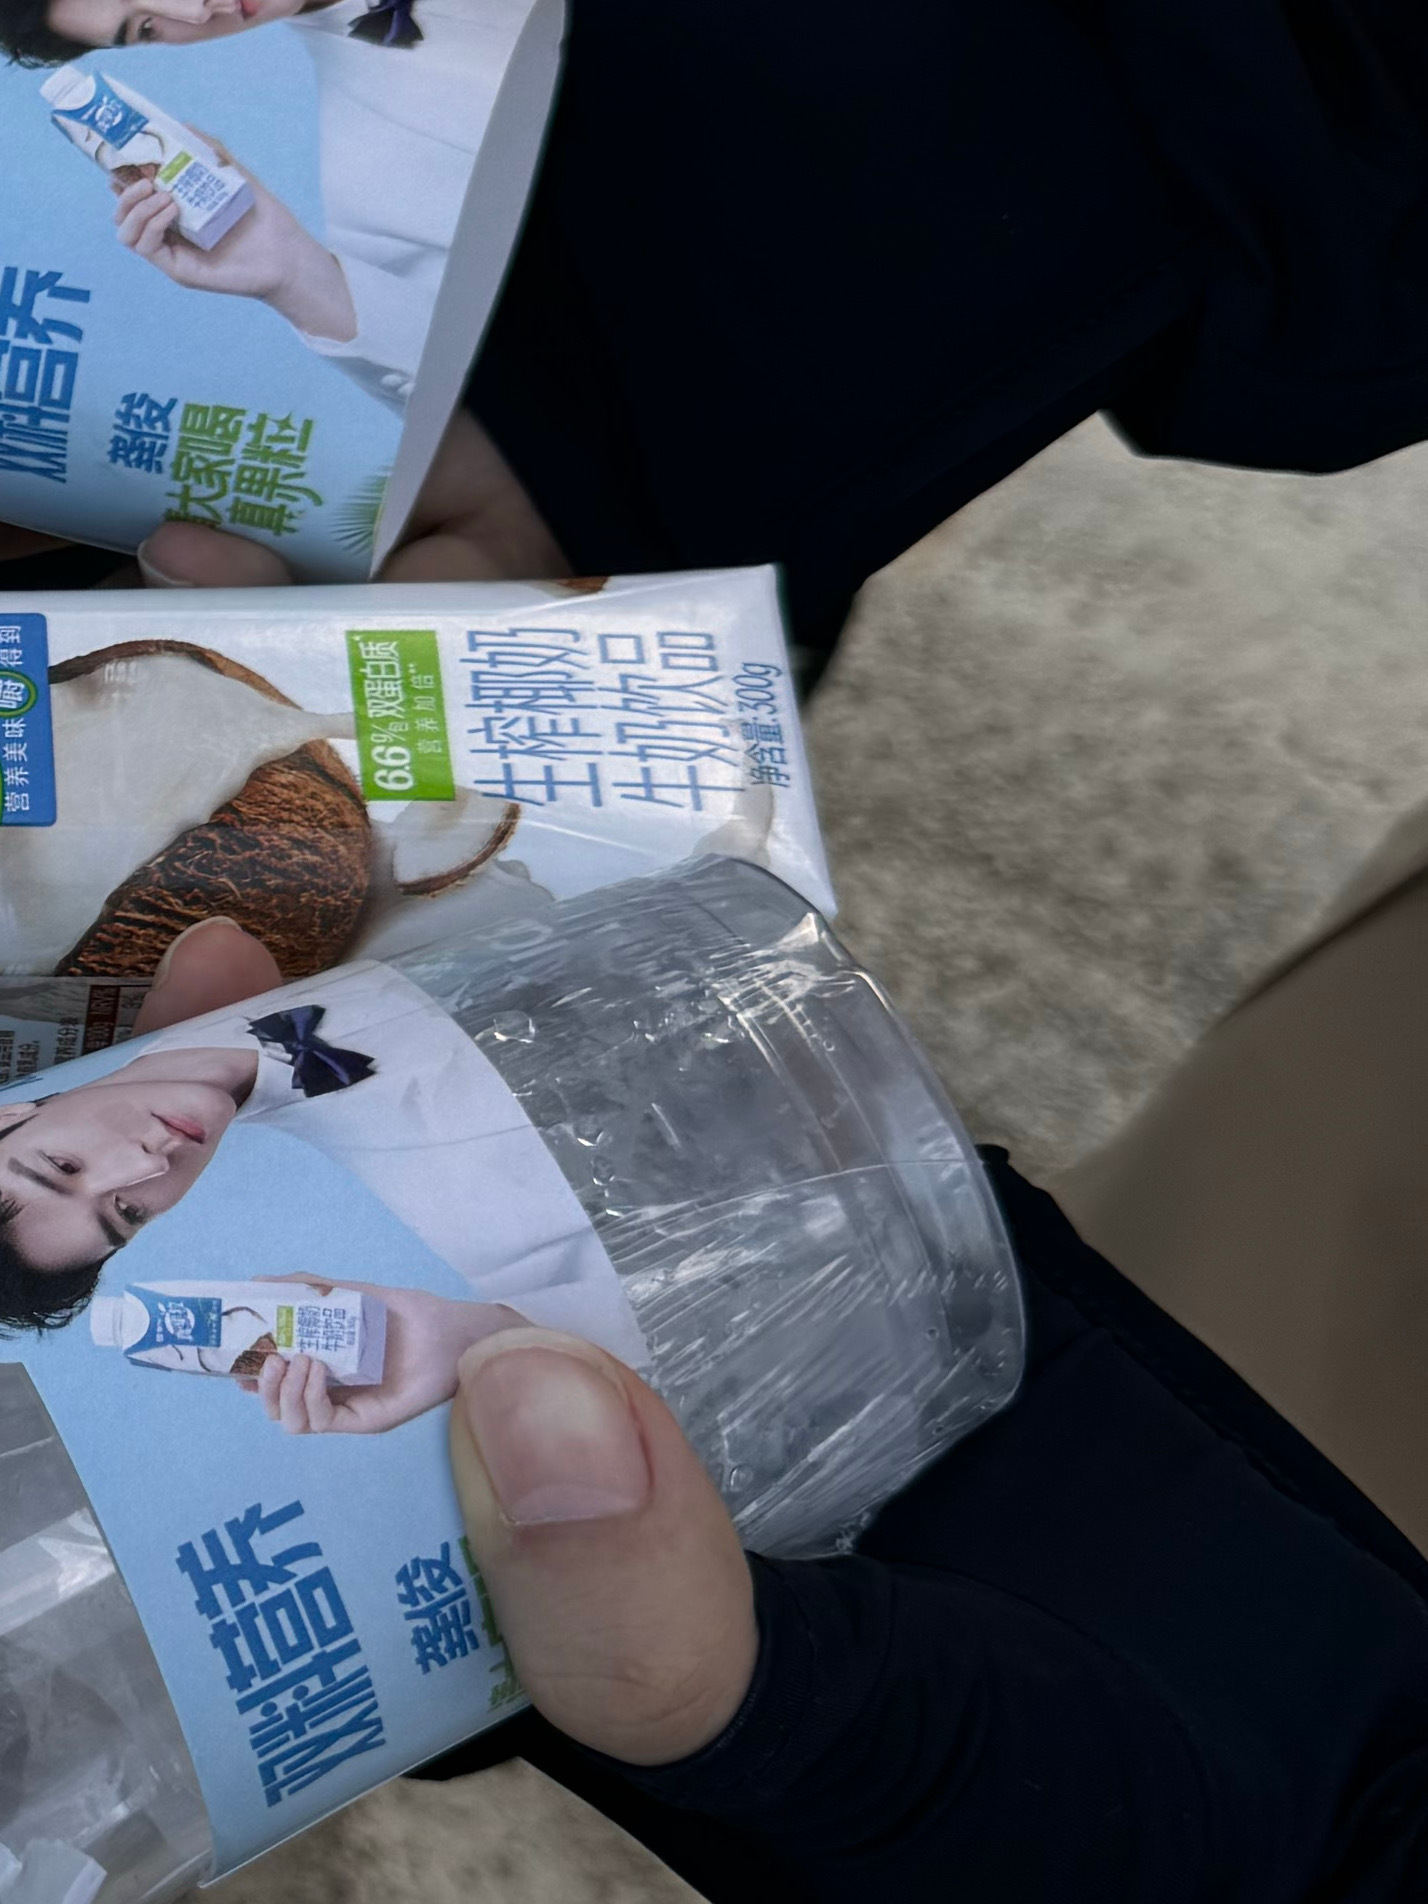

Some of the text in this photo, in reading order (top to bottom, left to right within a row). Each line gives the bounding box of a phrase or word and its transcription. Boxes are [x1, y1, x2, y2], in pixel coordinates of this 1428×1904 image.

[106, 391, 178, 476] 龚俊
[163, 402, 247, 530] 大家喝
[226, 410, 324, 538] 真果粒
[459, 627, 604, 808] 生榨椰奶
[597, 630, 744, 812] 牛奶饮品
[734, 661, 791, 789] 净含量:300g
[175, 1499, 387, 1809] 双料营养
[394, 1540, 482, 1676] 龚俊
